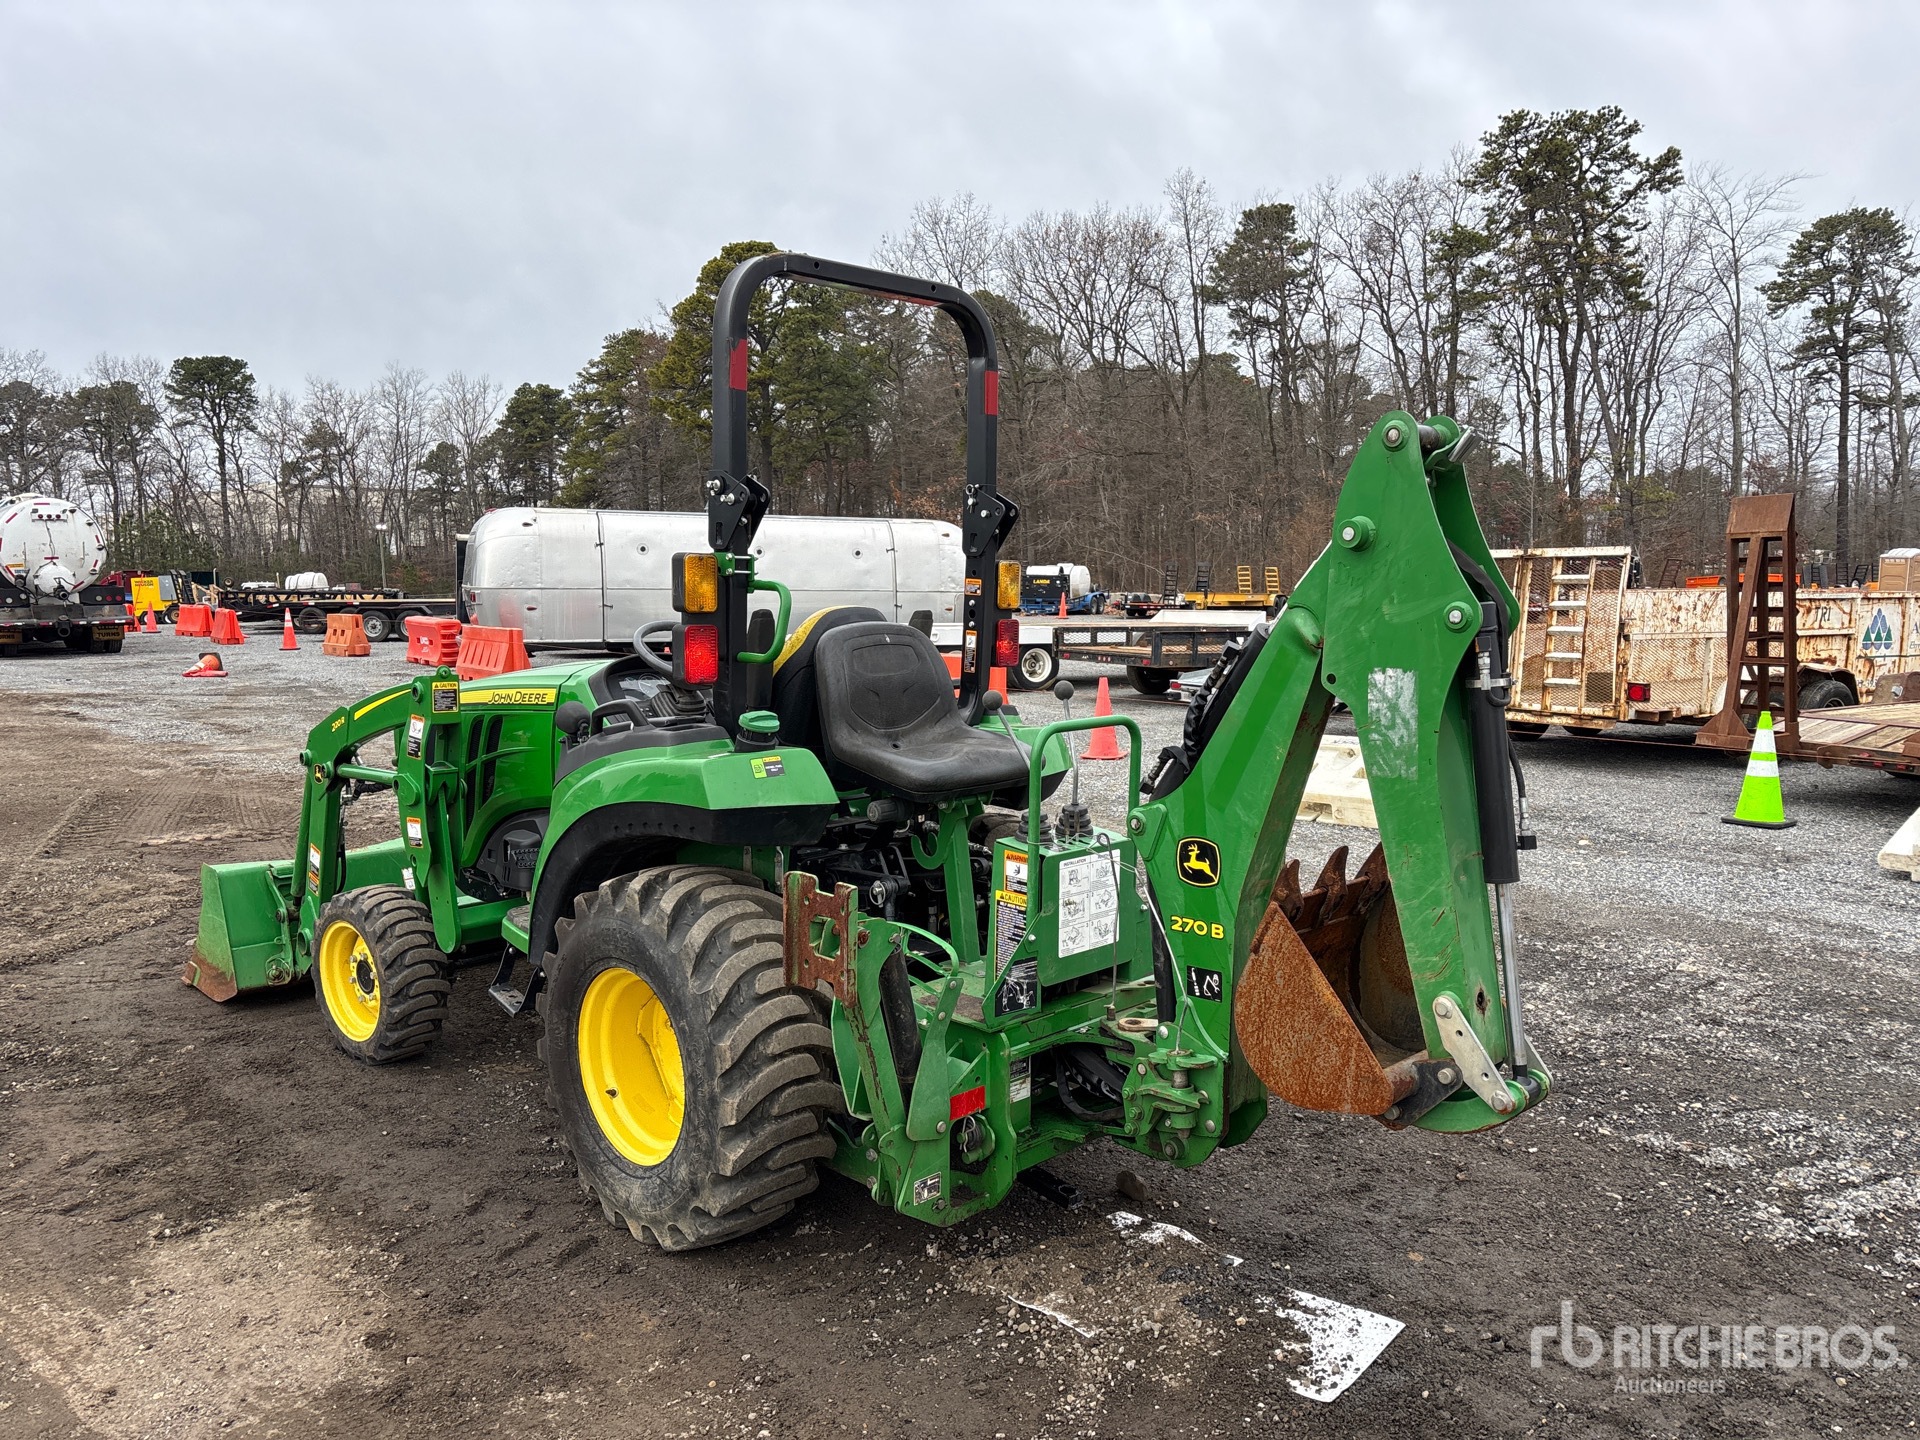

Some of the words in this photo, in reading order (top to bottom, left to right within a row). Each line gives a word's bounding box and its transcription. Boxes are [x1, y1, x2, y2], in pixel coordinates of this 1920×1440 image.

[488, 691, 513, 703] JOHN
[513, 691, 548, 703] DEERE
[1171, 915, 1208, 936] 270
[1211, 922, 1225, 939] B
